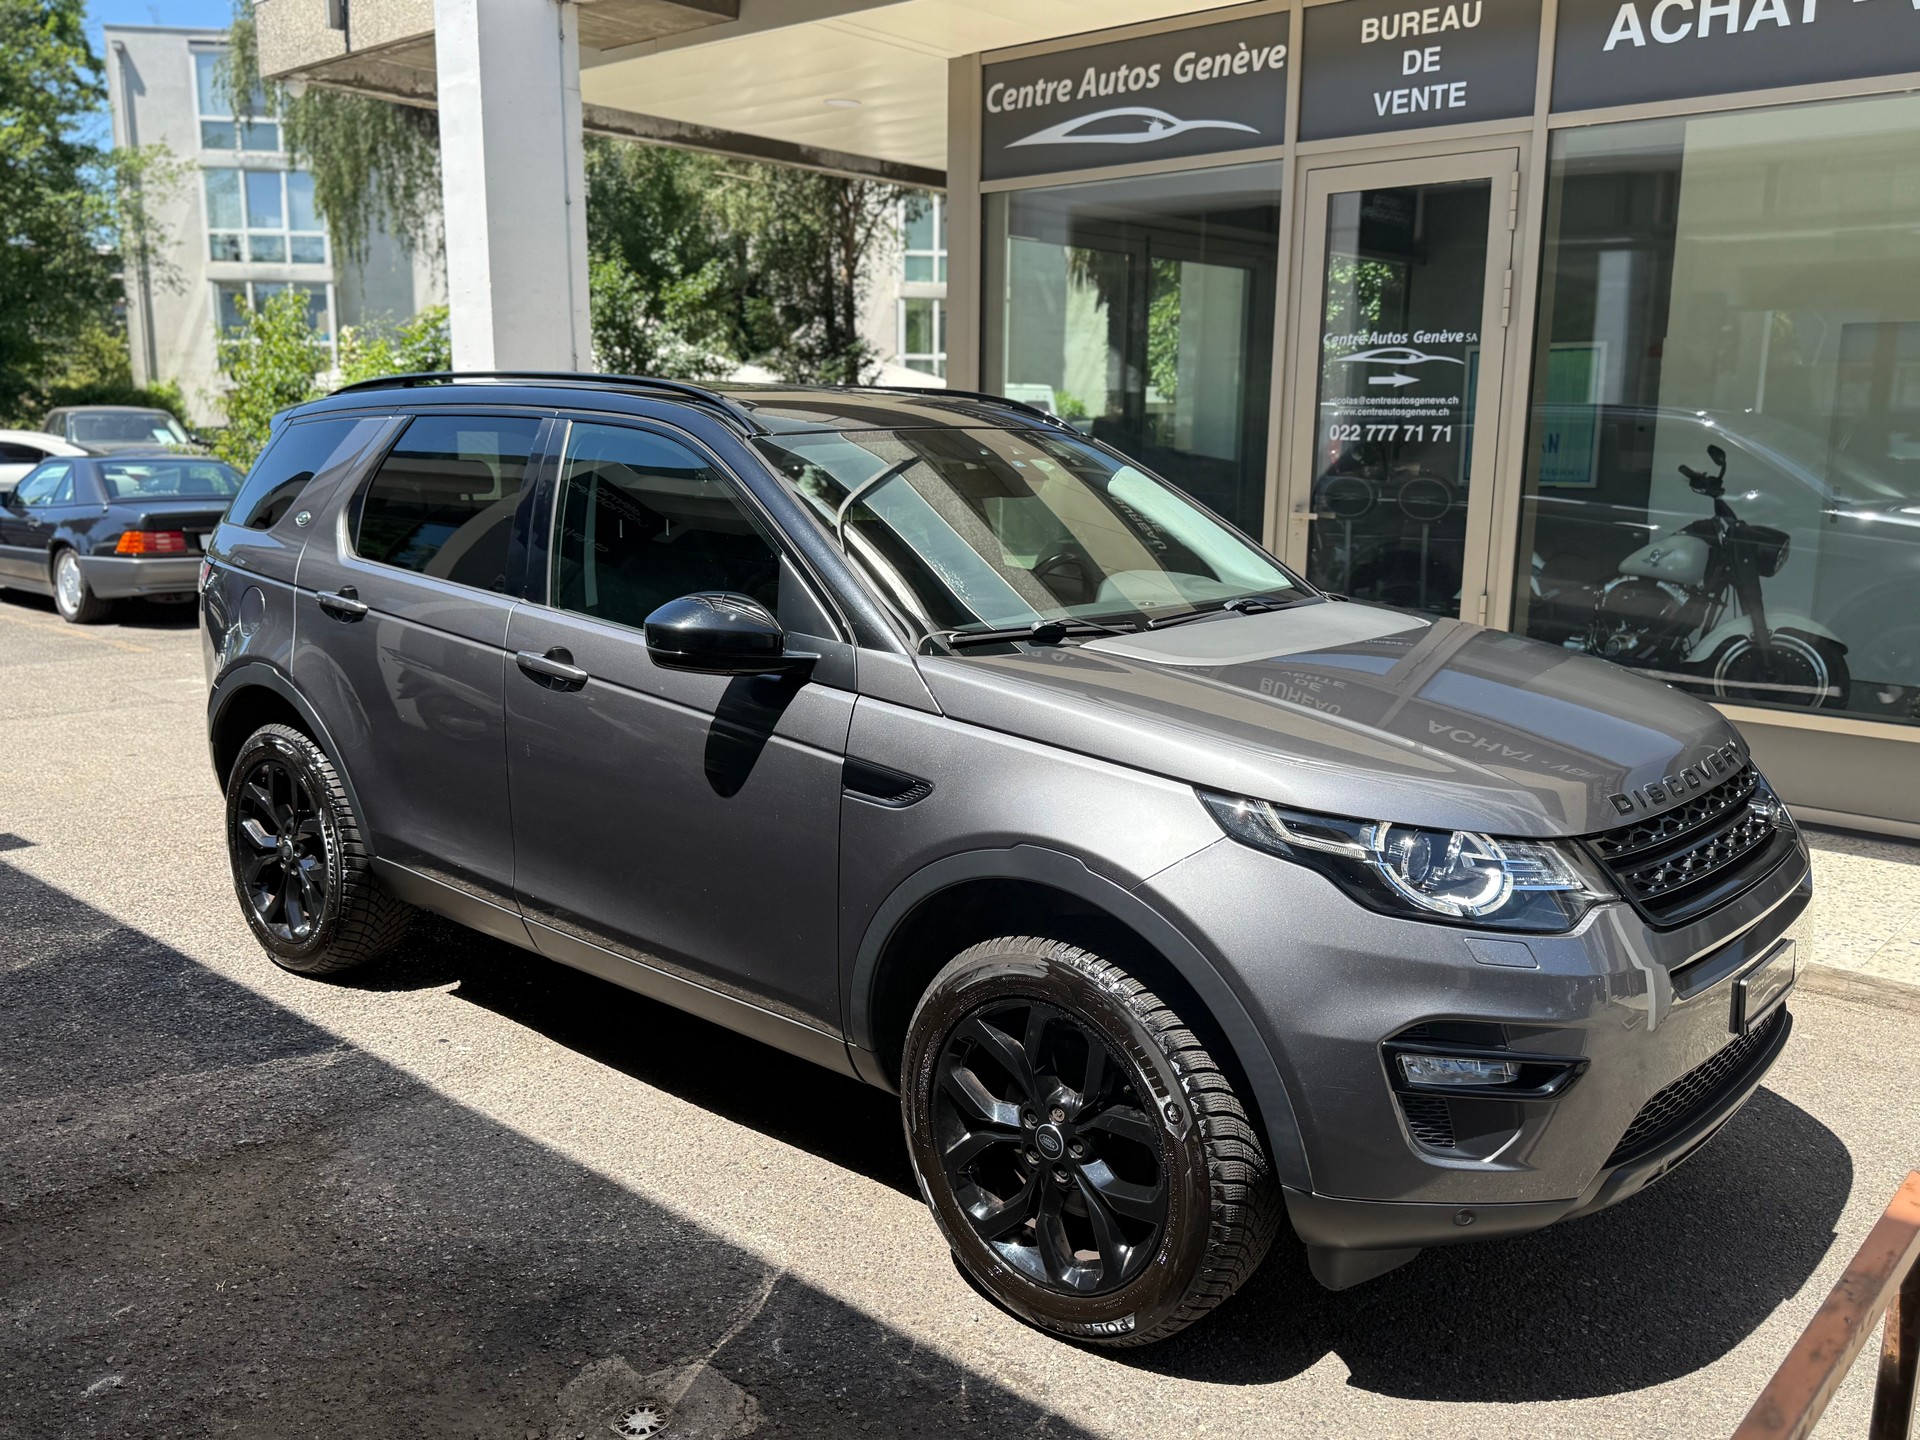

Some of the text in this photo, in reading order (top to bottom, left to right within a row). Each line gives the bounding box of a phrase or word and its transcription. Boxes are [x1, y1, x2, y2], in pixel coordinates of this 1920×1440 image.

[1361, 1, 1482, 44] BUREAU
[986, 42, 1287, 113] Centre Autos Genève
[1402, 46, 1441, 76] DE
[1373, 81, 1467, 117] VENTE
[1323, 329, 1478, 346] Centre Autos Genève SA
[1329, 425, 1451, 442] 022 777 71 71
[1607, 739, 1744, 816] DISCOVERY
